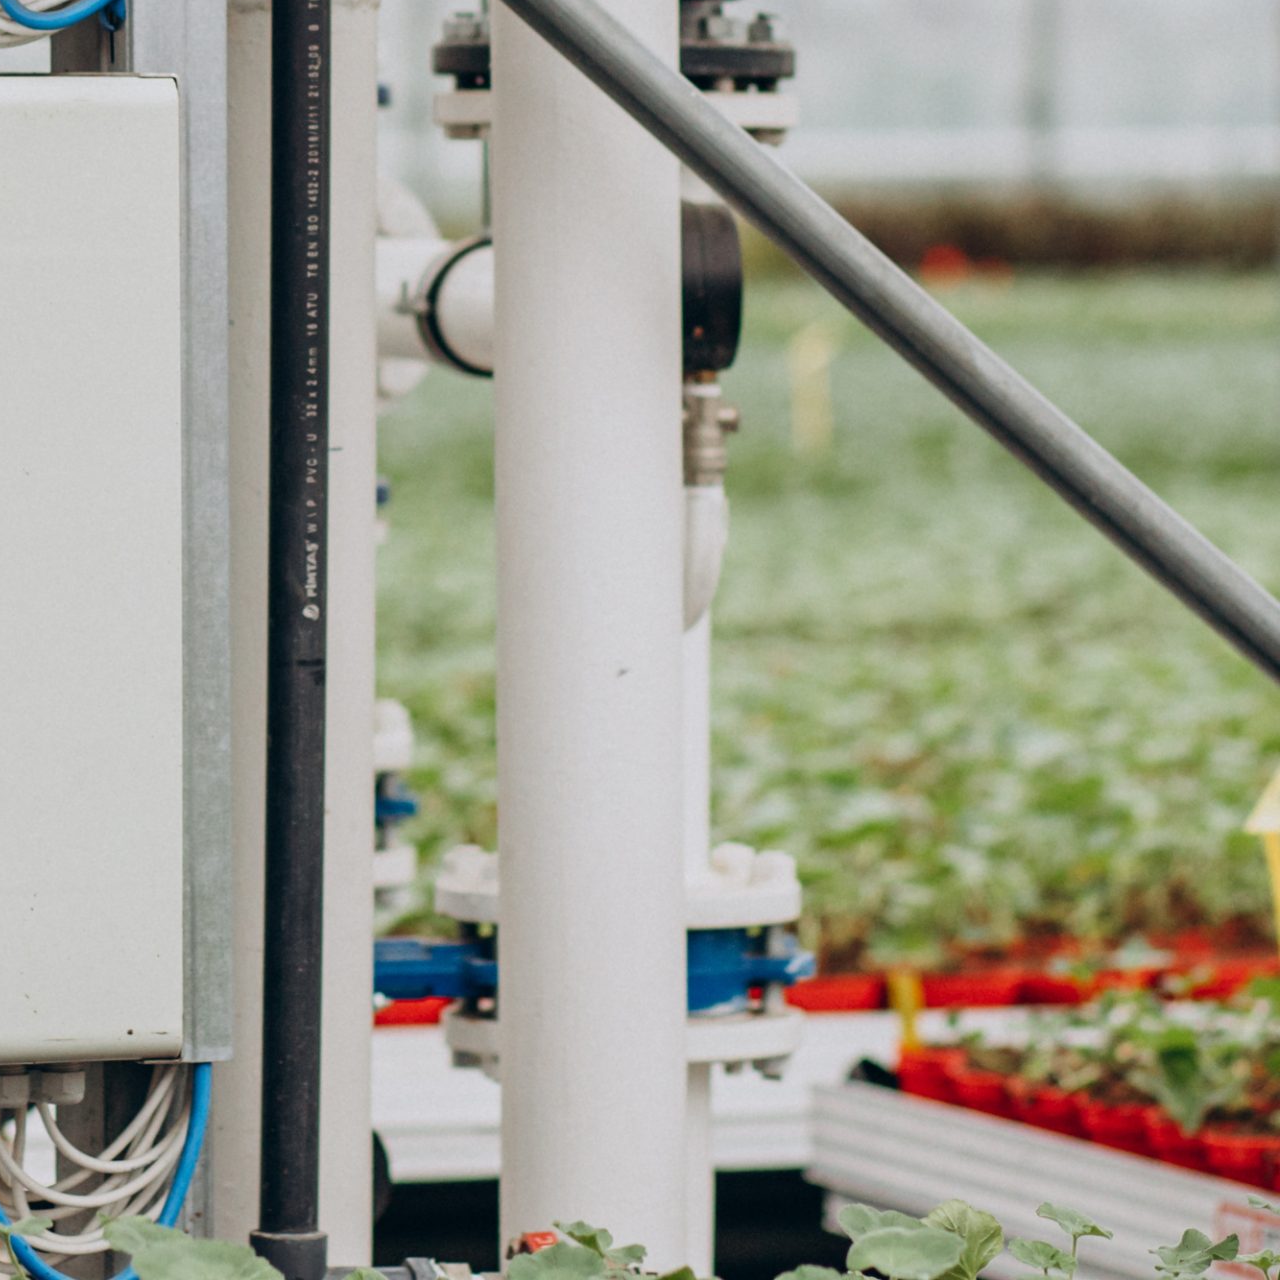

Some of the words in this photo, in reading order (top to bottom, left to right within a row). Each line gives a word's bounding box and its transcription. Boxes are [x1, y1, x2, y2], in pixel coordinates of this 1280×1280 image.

[308, 170, 319, 208] 1452-2
[307, 215, 318, 235] ISO
[307, 242, 318, 257] EN
[307, 292, 318, 318] ATU
[307, 433, 318, 441] U
[307, 458, 318, 483] PVC
